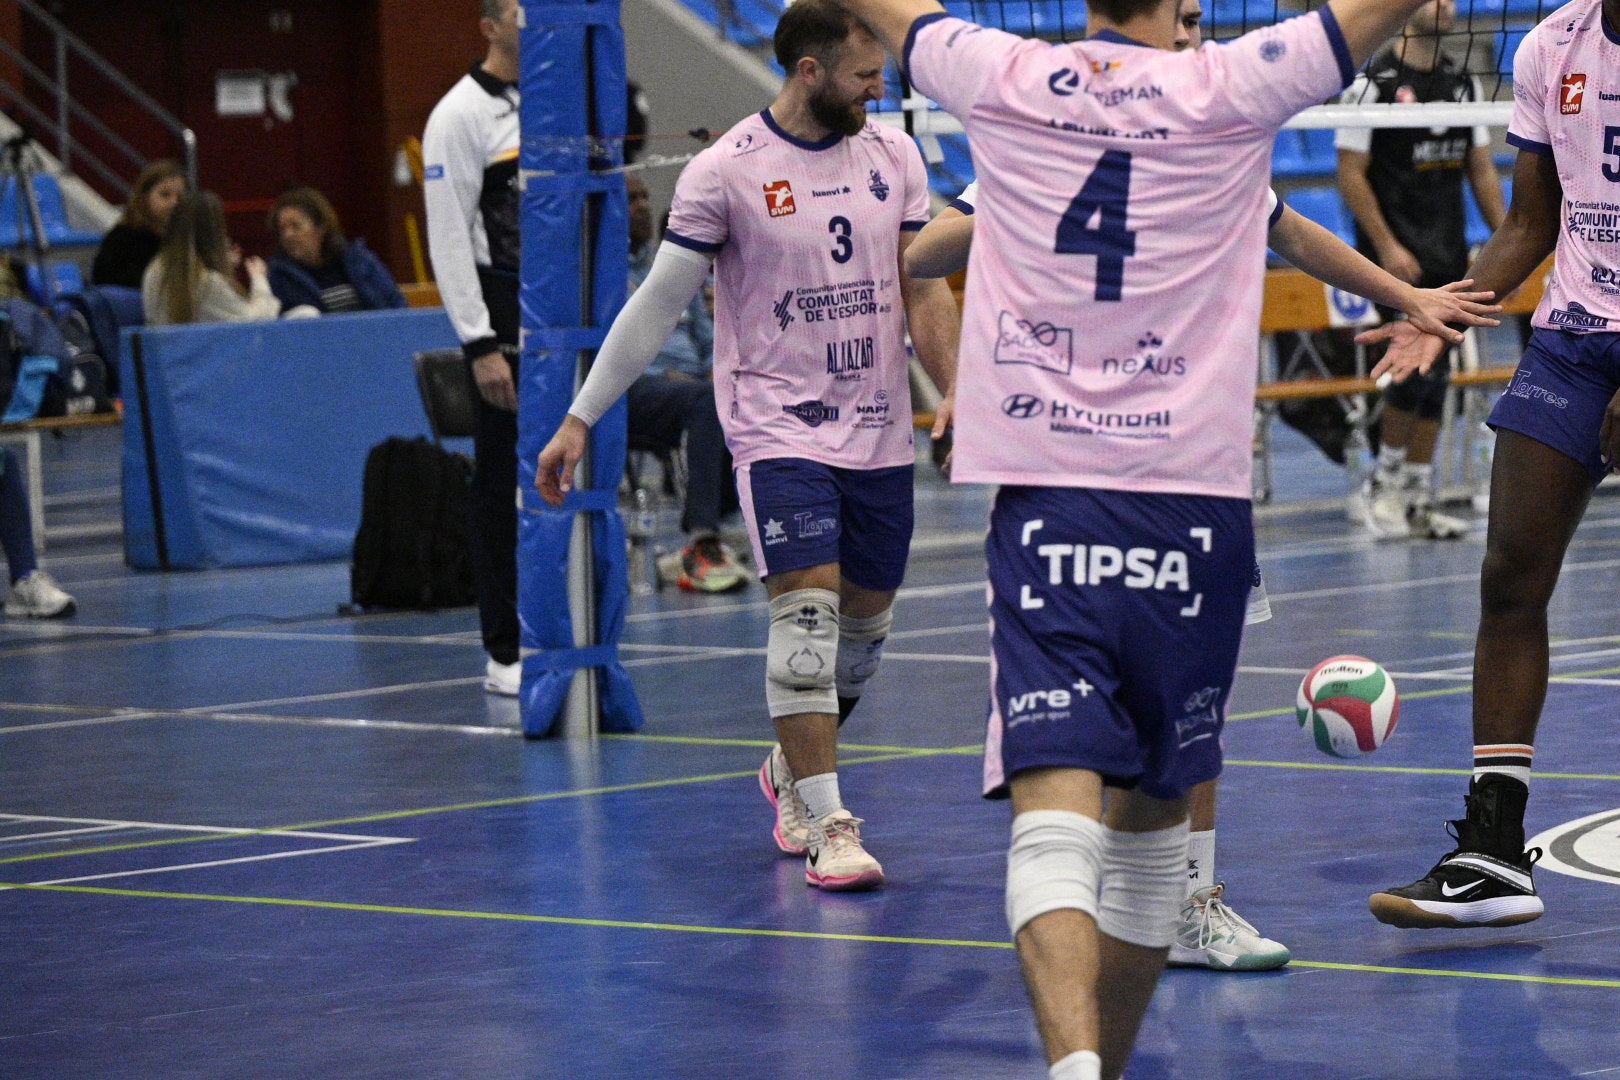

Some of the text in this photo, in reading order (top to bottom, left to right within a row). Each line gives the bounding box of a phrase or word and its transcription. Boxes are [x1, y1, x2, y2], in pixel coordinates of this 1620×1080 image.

[1562, 104, 1580, 113] SVM
[771, 206, 794, 216] SVM
[1054, 150, 1136, 302] 4
[828, 215, 853, 264] 3
[797, 288, 875, 311] COMUNITAT
[805, 308, 825, 323] DE
[1512, 369, 1569, 409] Torres
[1051, 400, 1171, 428] HYUNDAI
[1038, 544, 1190, 592] TIPSA
[1320, 665, 1363, 677] molten
